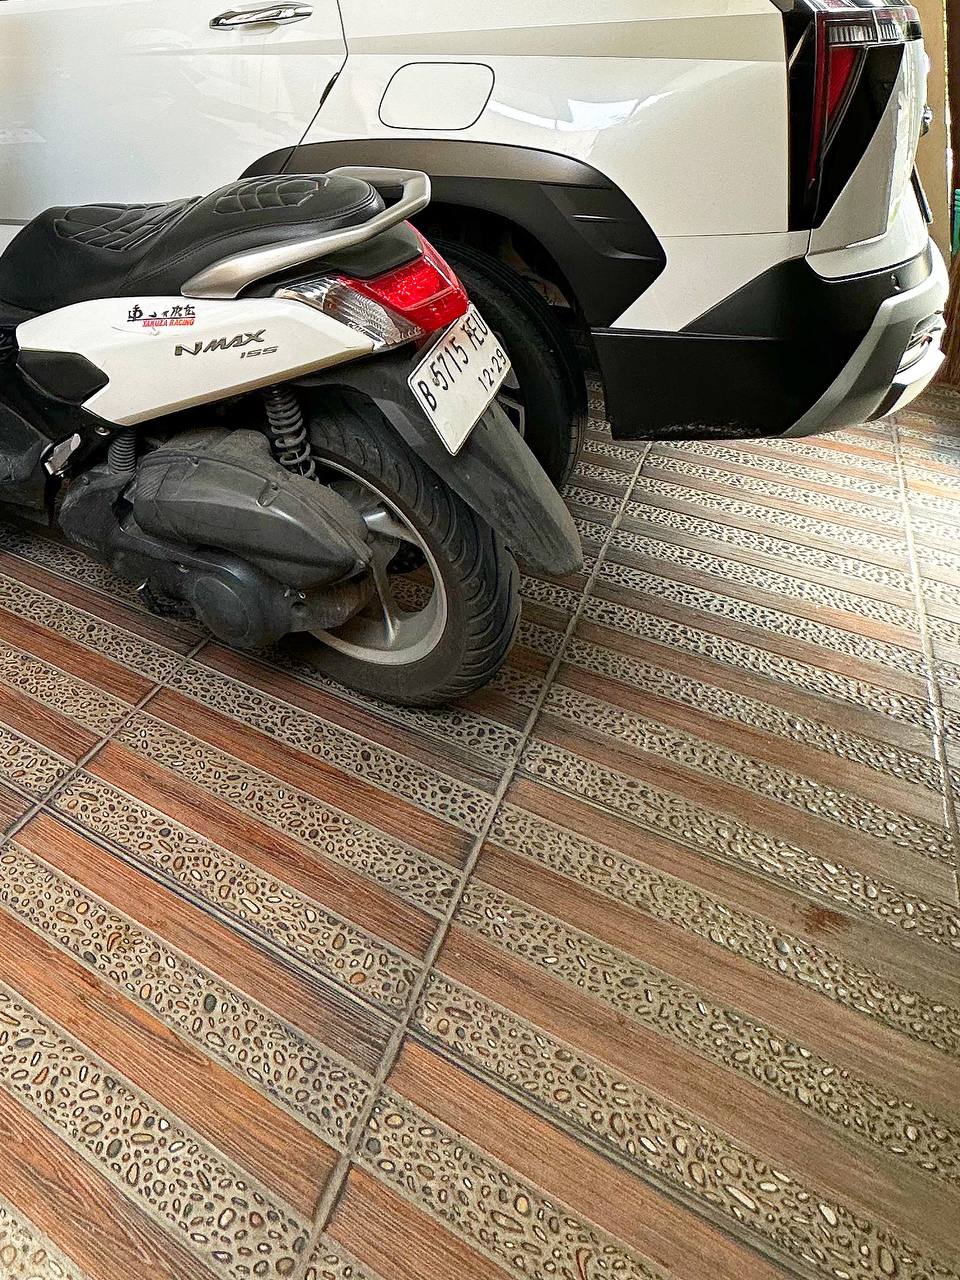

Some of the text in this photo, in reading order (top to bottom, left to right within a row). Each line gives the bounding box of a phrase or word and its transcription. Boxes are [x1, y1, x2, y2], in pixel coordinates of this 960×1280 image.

[174, 329, 267, 357] NMAX
[240, 345, 279, 359] 155
[418, 380, 437, 412] B
[430, 335, 469, 391] 5715
